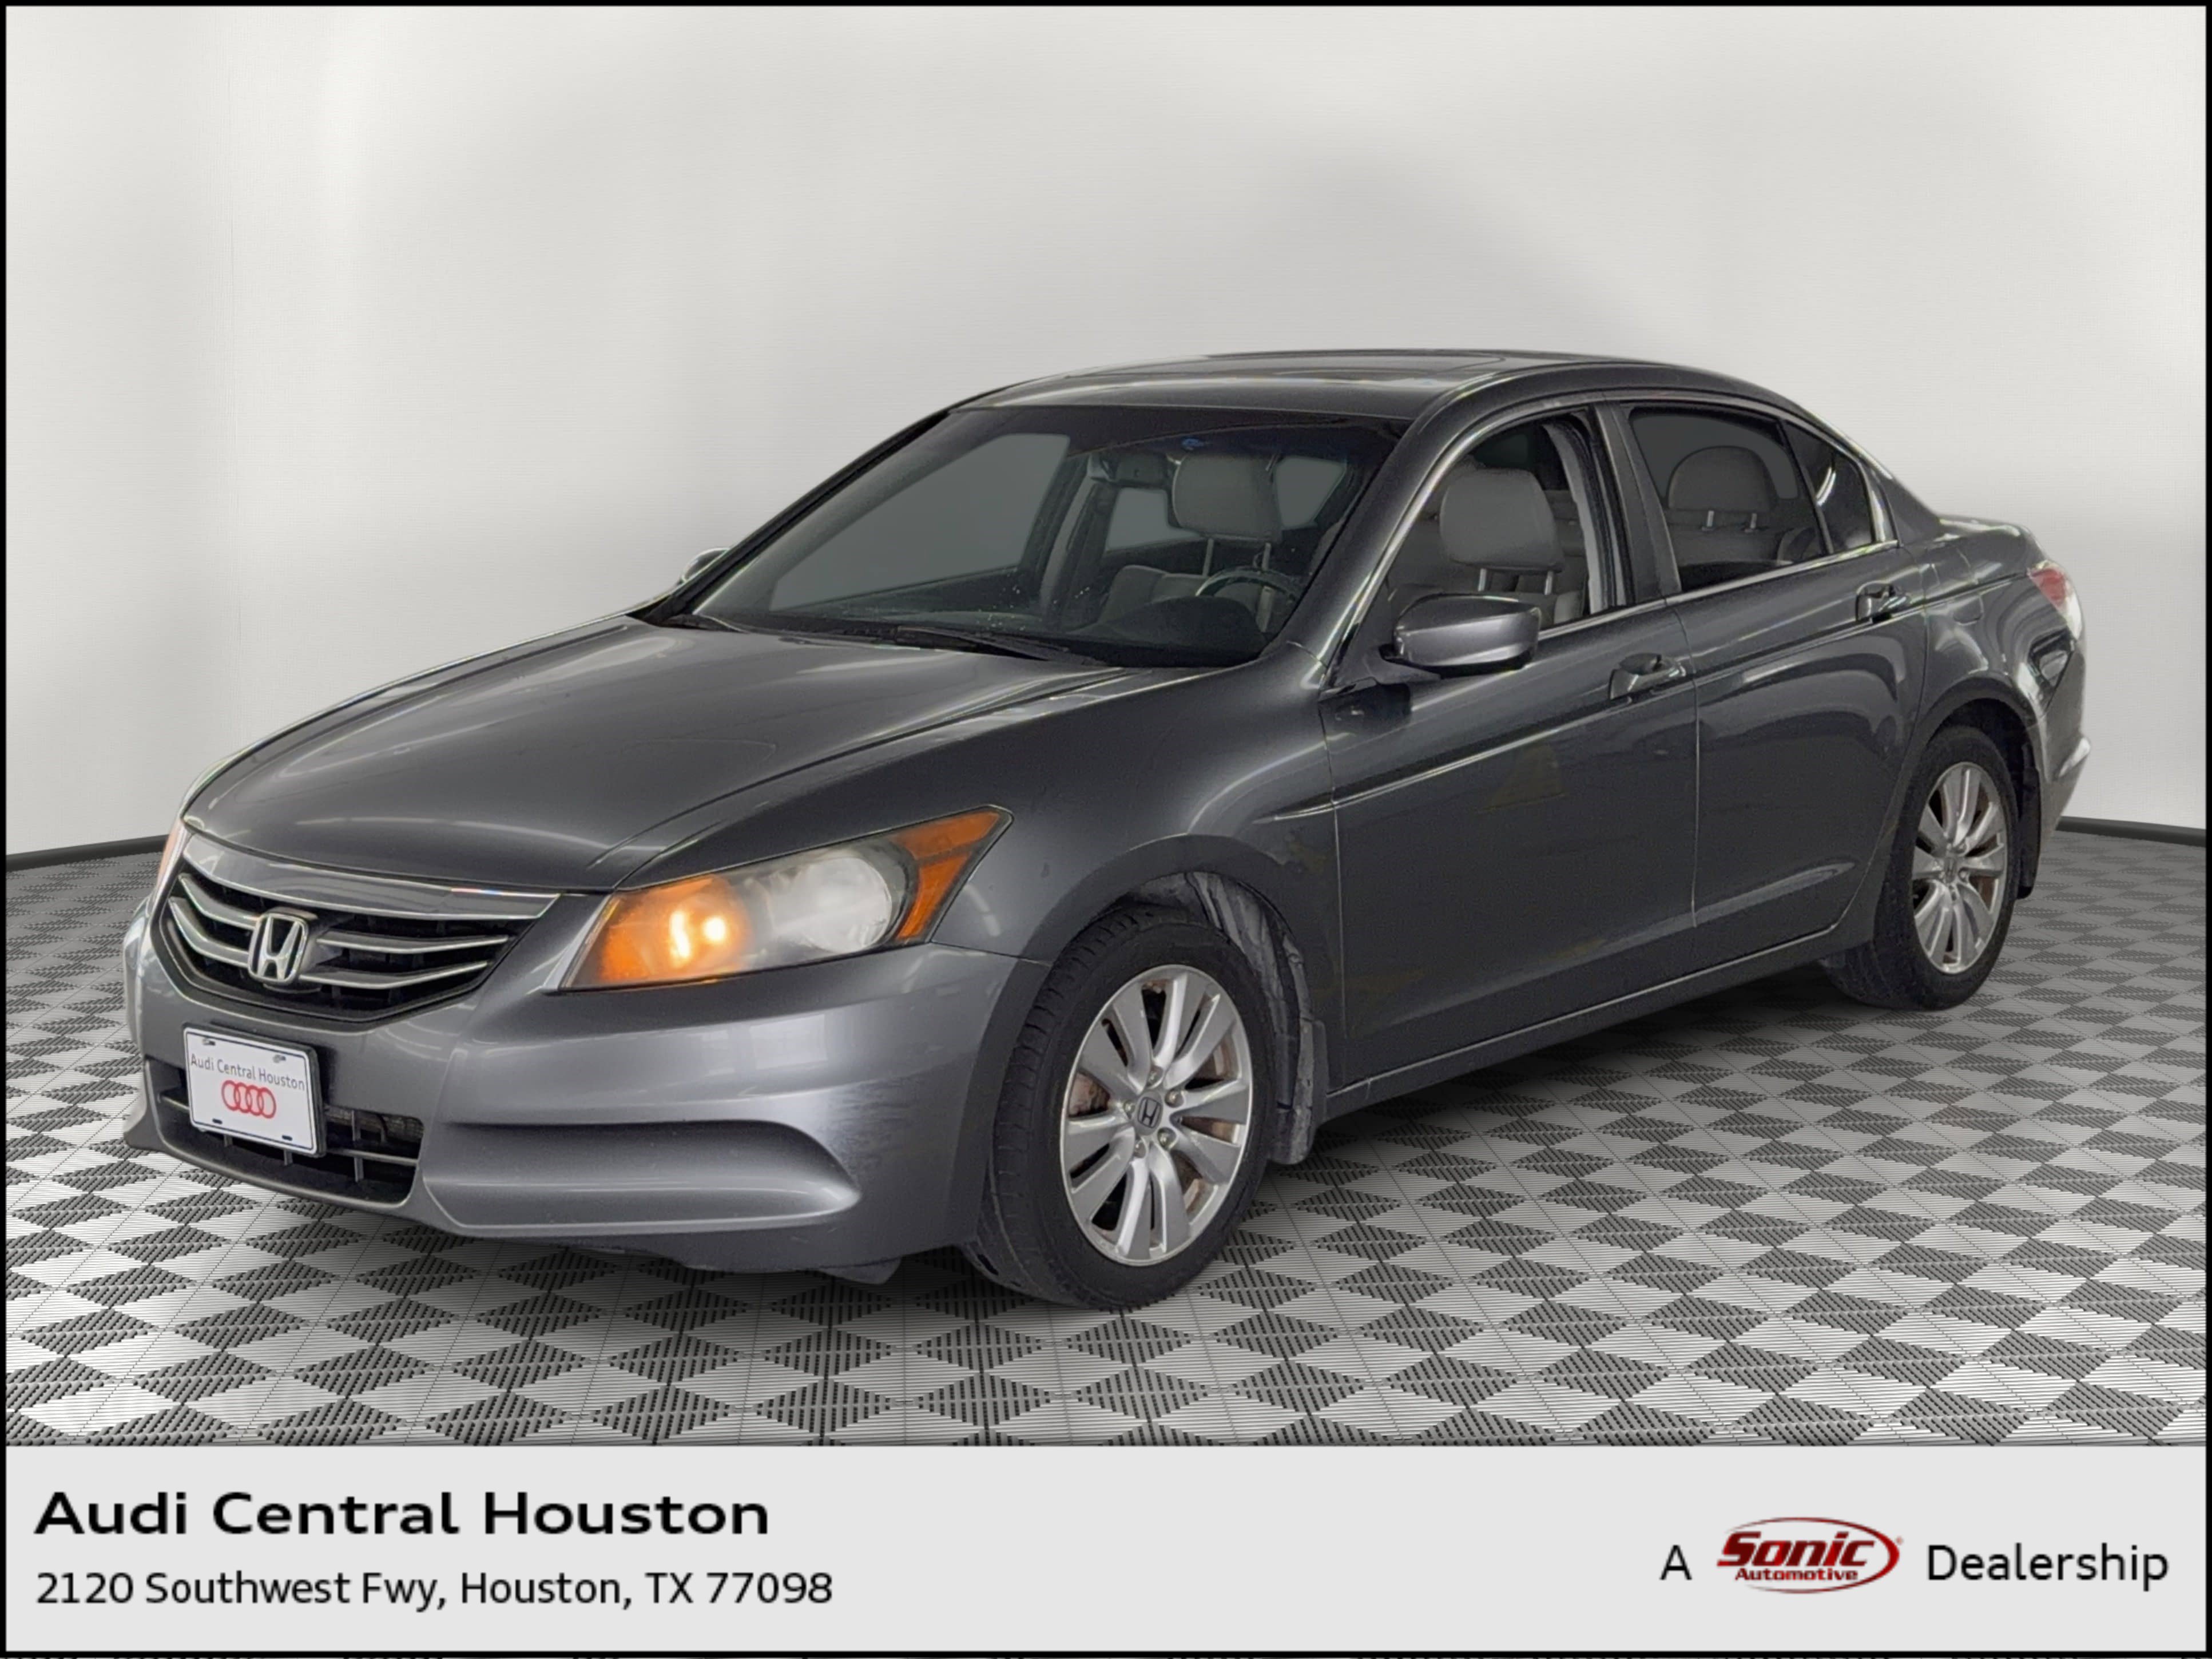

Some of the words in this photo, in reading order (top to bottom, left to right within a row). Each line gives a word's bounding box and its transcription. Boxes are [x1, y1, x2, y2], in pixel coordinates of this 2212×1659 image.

[191, 1053, 215, 1071] Audi
[217, 1059, 256, 1079] Central
[259, 1067, 305, 1092] Houston
